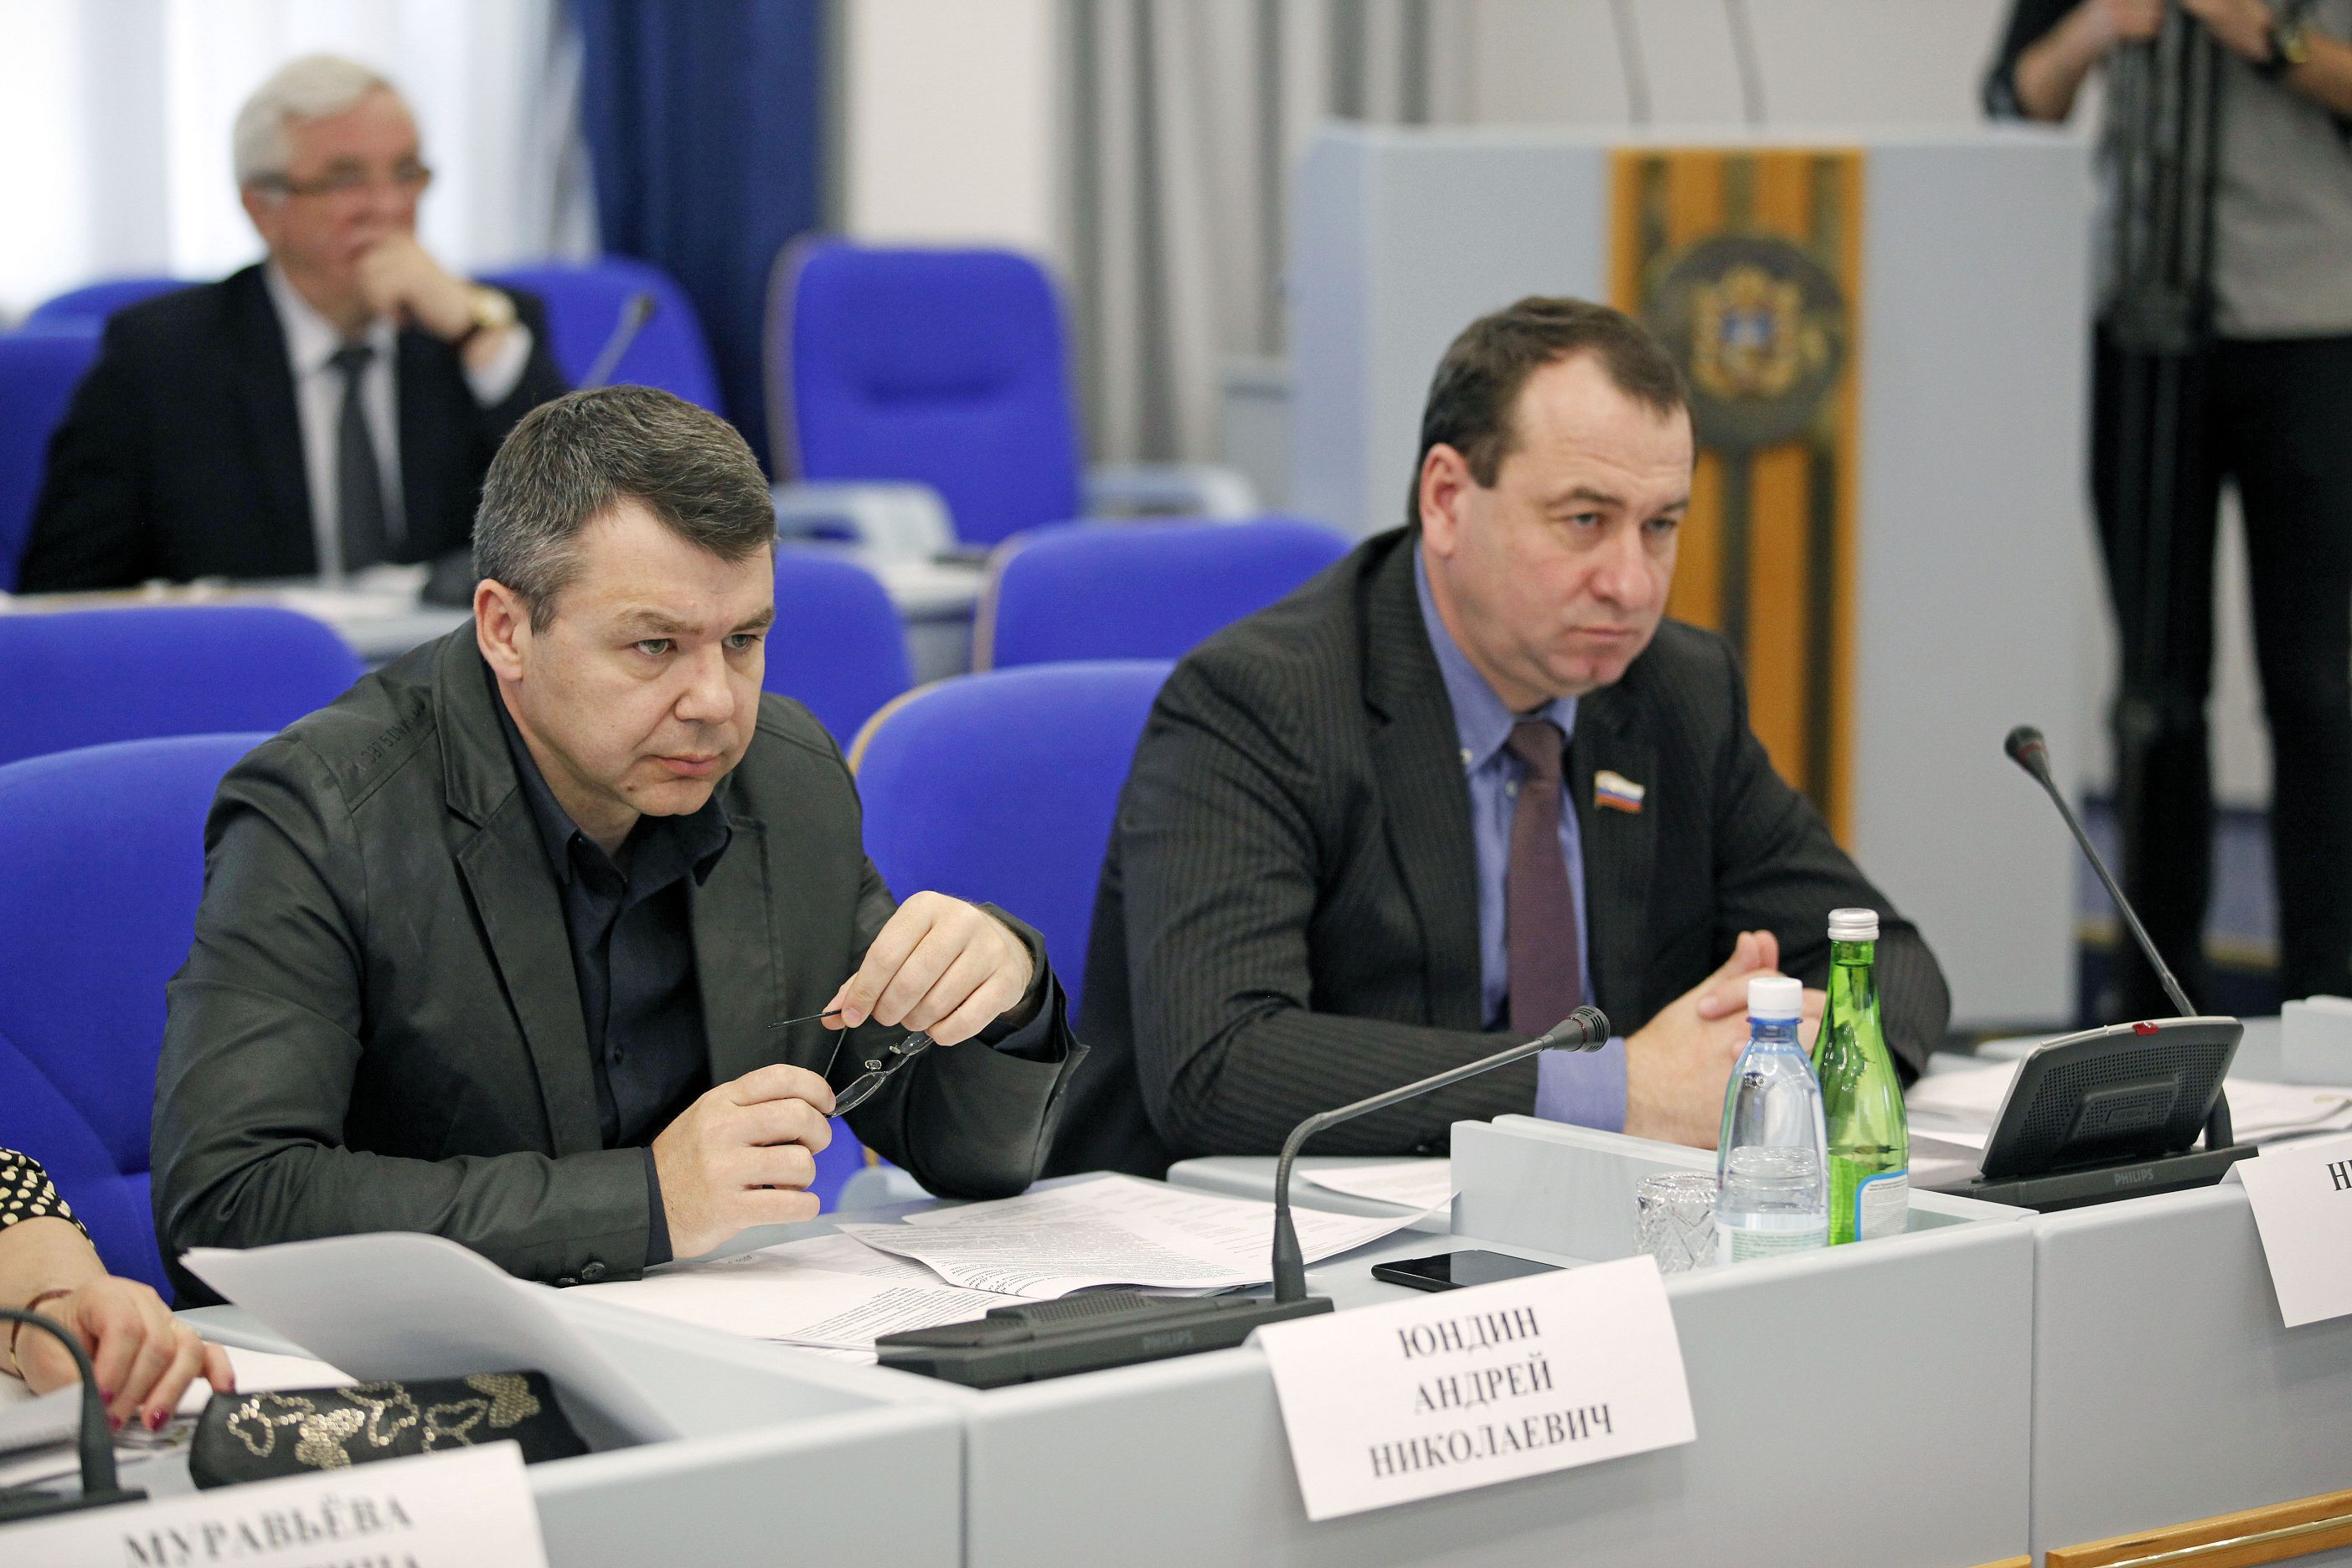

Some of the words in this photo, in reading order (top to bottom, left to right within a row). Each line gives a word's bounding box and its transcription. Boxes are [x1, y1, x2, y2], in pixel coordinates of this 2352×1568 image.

[2113, 1168, 2153, 1186] PHILIPS
[2325, 1160, 2352, 1191] Н
[1396, 1307, 1540, 1358] ЮНДИН
[1414, 1351, 1553, 1415] АНДРЕЙ
[1369, 1403, 1615, 1478] НИКОЛАЕВИЧ
[124, 1492, 415, 1568] МУРАВЬЁВА
